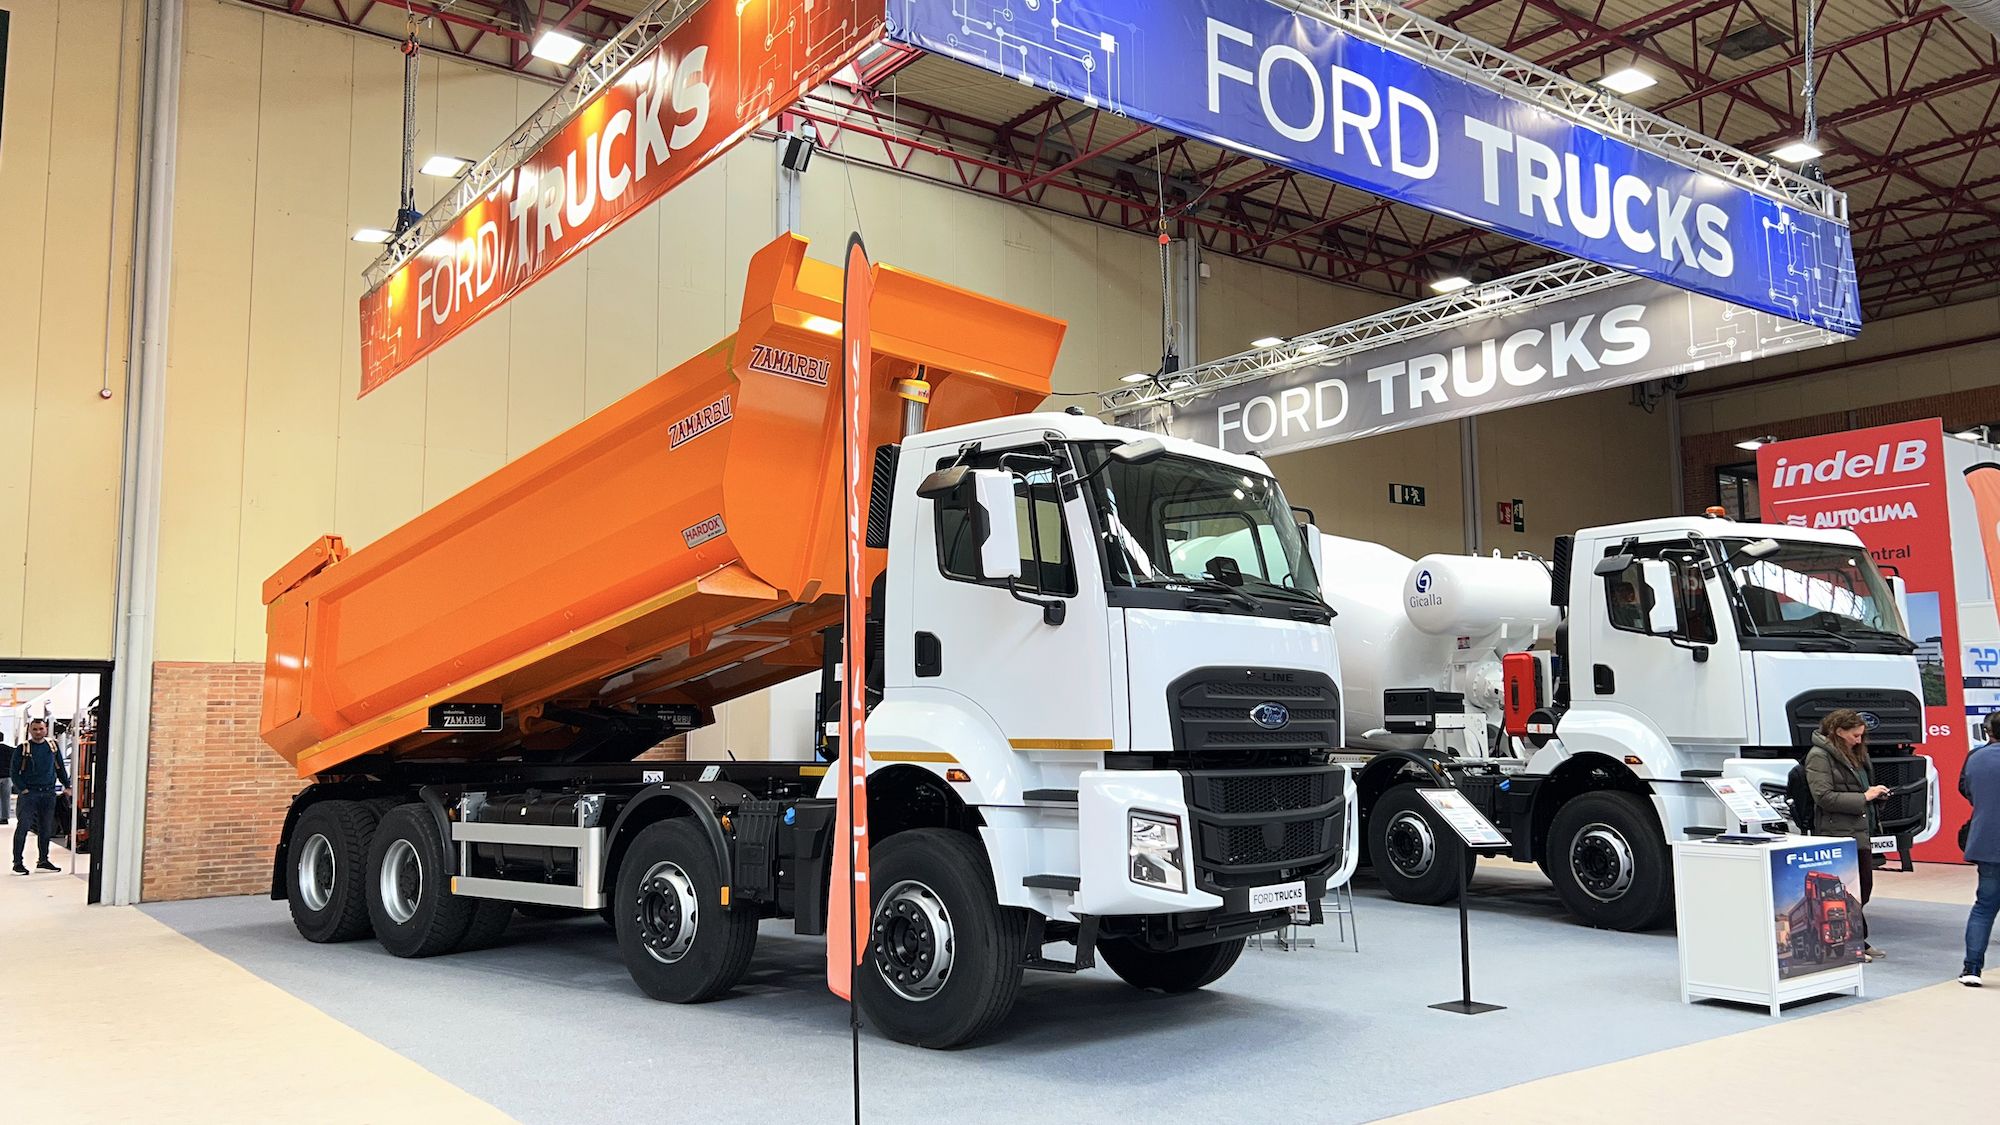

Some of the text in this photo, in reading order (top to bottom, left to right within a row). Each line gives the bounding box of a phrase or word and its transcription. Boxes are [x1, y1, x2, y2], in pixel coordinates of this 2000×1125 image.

[1205, 16, 1735, 279] FORD TRUCKS
[416, 45, 710, 339] FORD TRUCKS
[1216, 304, 1652, 450] FORD TRUCKS
[1813, 501, 1919, 529] AUTOCLIMA
[685, 517, 720, 541] HARDOX
[1870, 545, 1911, 560] ntral
[1410, 594, 1442, 608] Gicalla
[1261, 706, 1286, 724] Ford
[1253, 889, 1302, 904] FORD TRUCKS
